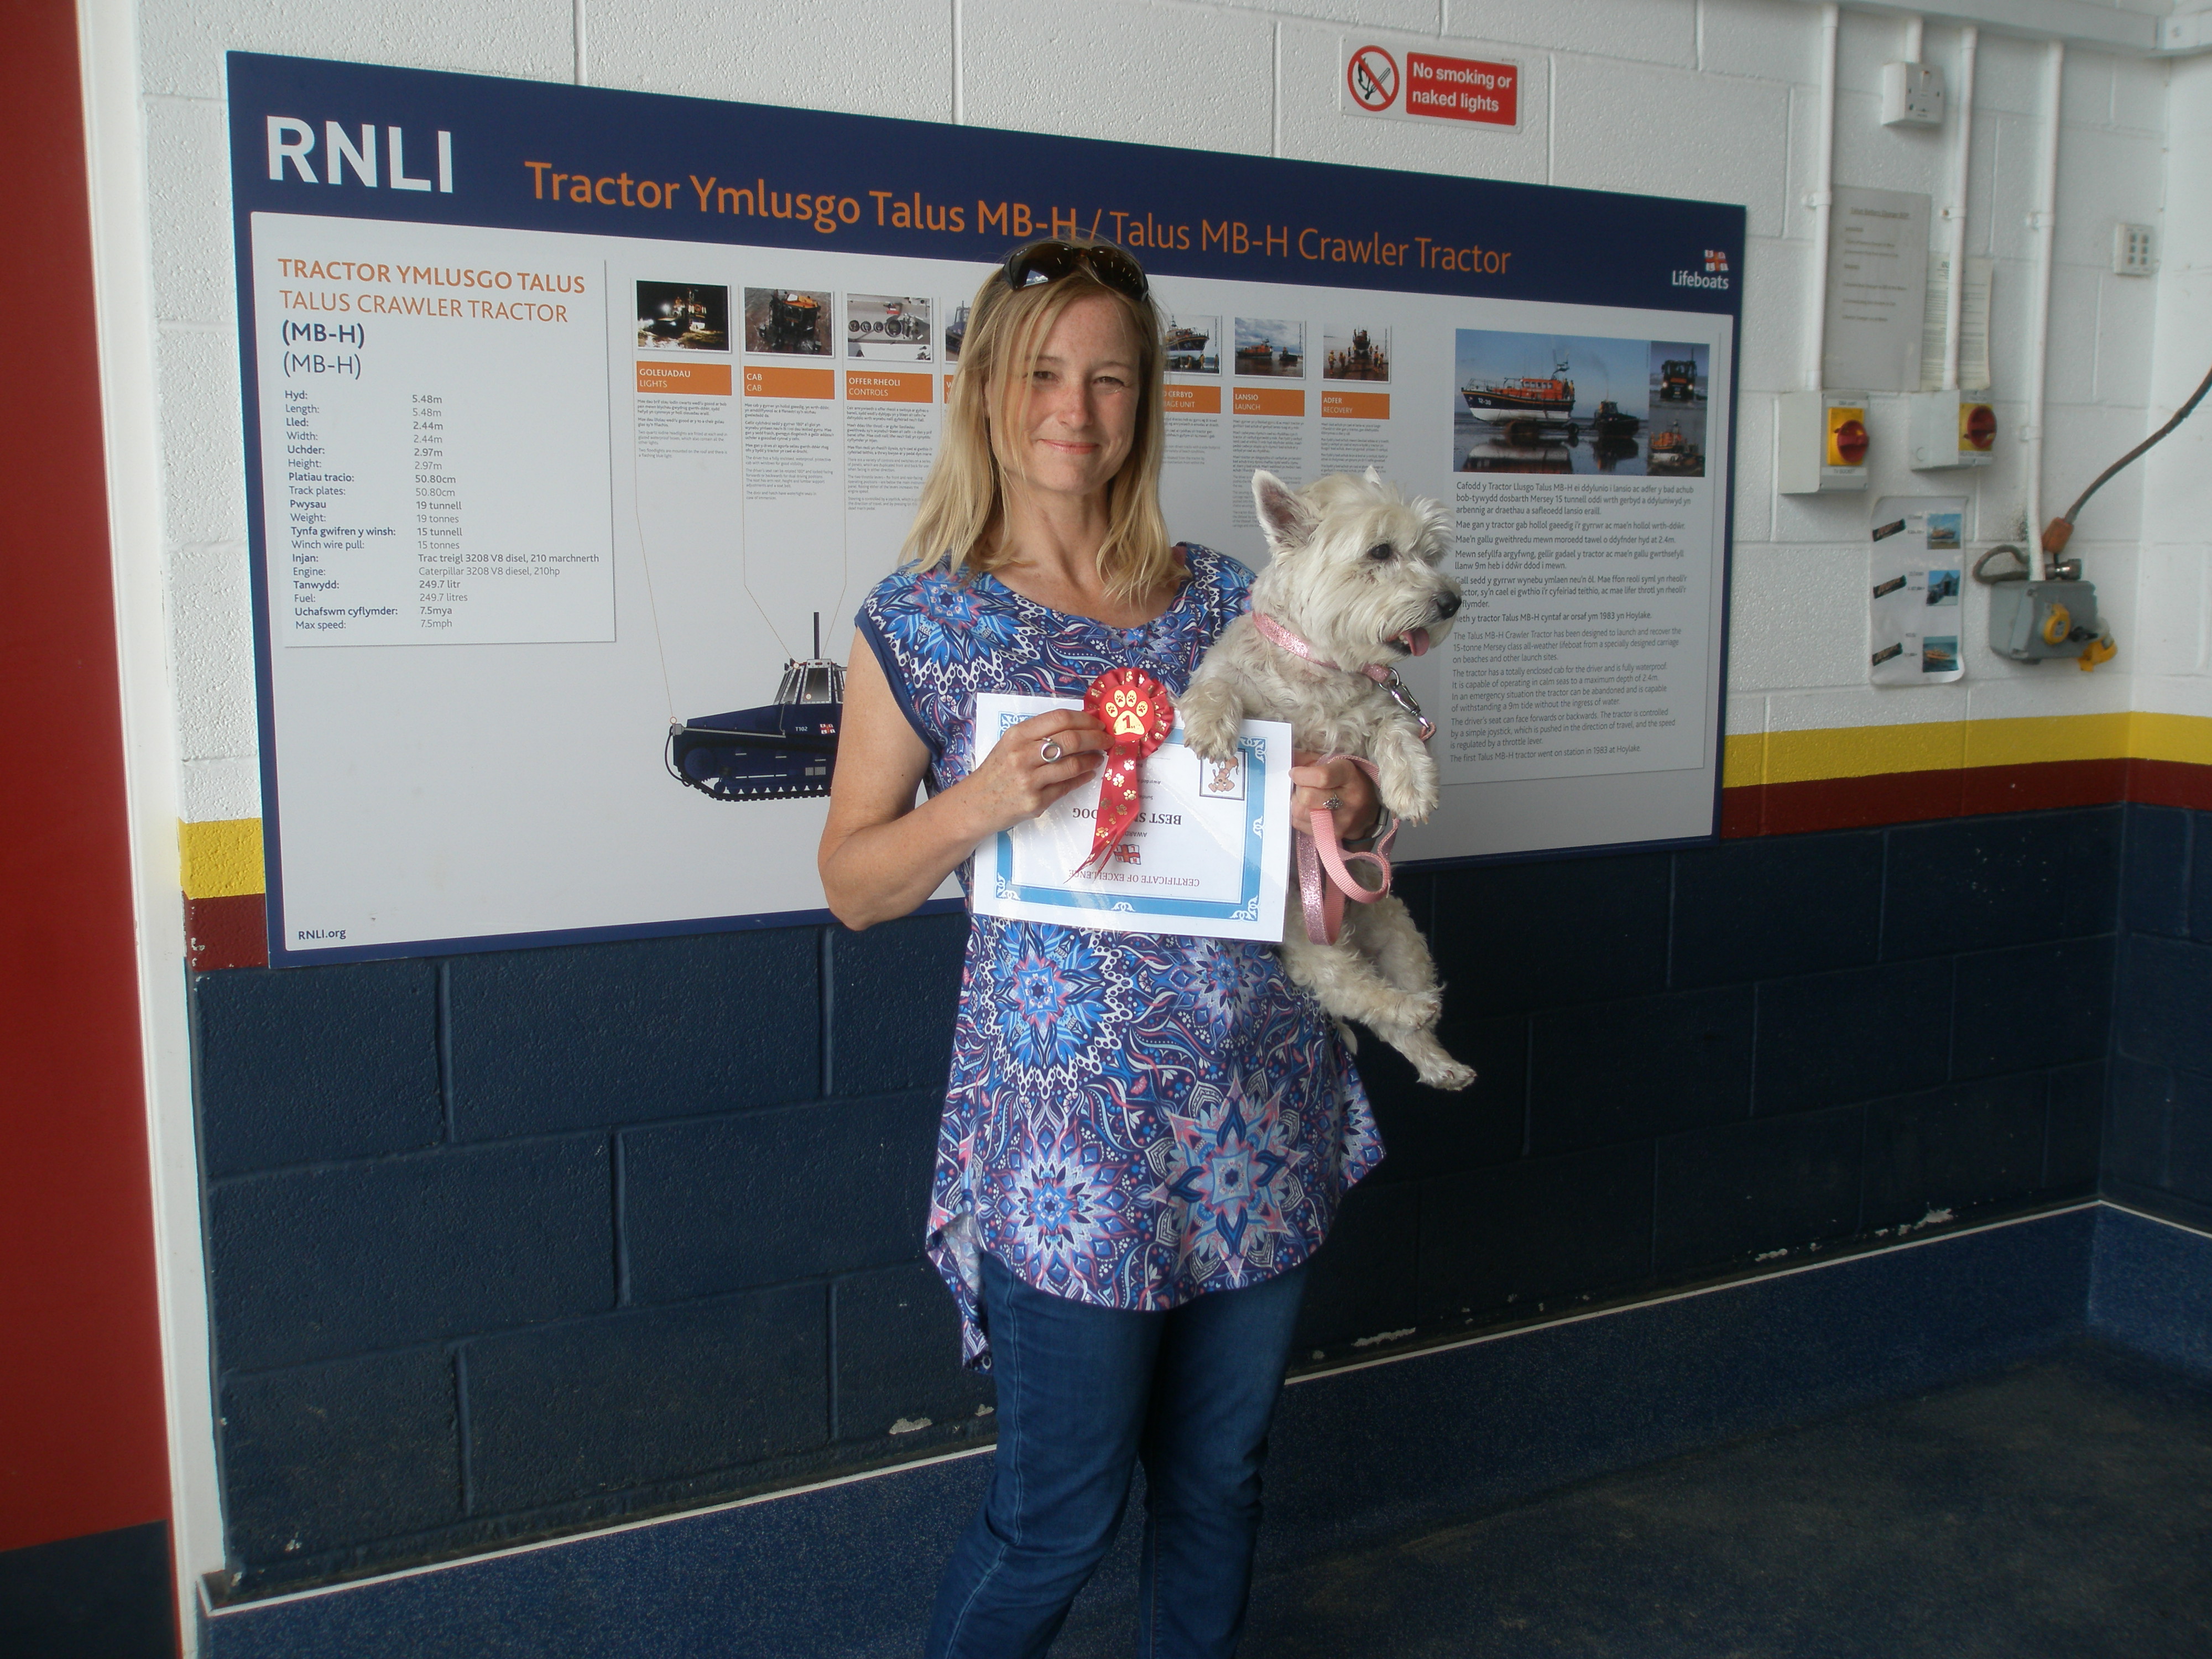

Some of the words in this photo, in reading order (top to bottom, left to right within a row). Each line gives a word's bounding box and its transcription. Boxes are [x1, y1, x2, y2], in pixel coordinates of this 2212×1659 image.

[1413, 62, 1432, 79] No
[1436, 69, 1494, 90] smoking
[1498, 76, 1512, 88] or
[1413, 90, 1457, 106] naked
[1461, 93, 1499, 112] lights
[267, 116, 452, 193] RNLI
[524, 161, 680, 208] Tractor
[690, 175, 860, 233] Ymlusgo
[869, 191, 964, 232] Talus
[978, 200, 1076, 239] MB-H
[1109, 211, 1190, 249] Talus
[1202, 220, 1287, 257] MB-H
[1299, 228, 1408, 265] Crawler
[1415, 237, 1511, 274] Tractor
[278, 259, 390, 282] TRACTOR
[397, 265, 512, 289] YMLUSGO
[517, 273, 585, 293] TALUS
[1672, 270, 1729, 289] Lifeboats
[279, 290, 350, 311] TALUS
[358, 295, 462, 317] CRAWLER
[468, 300, 567, 322] TRACTOR
[283, 320, 364, 349] (MB-H)
[284, 351, 361, 380] (MB-H)
[639, 368, 691, 378] GOLEUADAU
[640, 379, 667, 388] LIGHTS
[285, 390, 307, 401] Hyd:
[413, 395, 442, 403] 5.48m
[286, 404, 319, 415] Length:
[413, 408, 441, 416] 5.48m
[286, 418, 309, 426] Lled:
[414, 421, 443, 430] 2.44m
[286, 431, 317, 440] Width:
[414, 435, 442, 443] 2.44m
[288, 445, 325, 454] Uchder:
[414, 448, 442, 456] 2.97m
[289, 459, 321, 470] Height:
[415, 461, 442, 469] 2.97m
[289, 472, 321, 481] Platiau
[324, 473, 354, 482] tracio:
[416, 474, 456, 483] 50.80cm
[289, 486, 313, 494] Track
[316, 486, 345, 497] plates:
[416, 488, 455, 496] 50.80cm
[290, 499, 326, 510] Pwysau
[416, 501, 426, 509] 19
[290, 513, 326, 524] Weight:
[417, 514, 426, 523] 19
[291, 526, 317, 538] Tynfa
[320, 526, 356, 538] gwifren
[358, 529, 363, 538] y
[366, 527, 395, 535] winsh:
[430, 528, 462, 536] tunnell
[1477, 535, 1493, 545] gallu
[1495, 535, 1531, 545] gweithredu
[1609, 535, 1637, 545] ddyfnder
[1639, 536, 1650, 545] hyd
[291, 540, 321, 549] Winch
[324, 540, 342, 549] wire
[346, 540, 364, 551] pull:
[293, 554, 318, 565] Injan:
[440, 554, 463, 564] treigl
[506, 554, 528, 563] disel,
[294, 567, 325, 578] Engine:
[419, 567, 464, 577] Caterpillar
[505, 567, 531, 576] diesel,
[534, 567, 560, 577] 210hp
[293, 580, 339, 591] Tanwydd:
[295, 594, 315, 602] Fuel:
[295, 607, 345, 615] Uchafswm
[348, 607, 398, 618] cyflymder:
[420, 607, 452, 617] 7.5mya
[318, 620, 346, 631] speed:
[421, 619, 452, 629] 7.5mph
[1582, 629, 1608, 639] designed
[1122, 715, 1135, 728] 1st
[1594, 746, 1608, 754] 1983
[1617, 745, 1641, 754] Hoylake.
[1149, 813, 1182, 825] BEST
[1069, 870, 1124, 881] EXCELLENCE
[1126, 874, 1139, 883] OF
[1141, 875, 1200, 886] CERTIFICATE
[299, 930, 347, 940] RNLI.org
